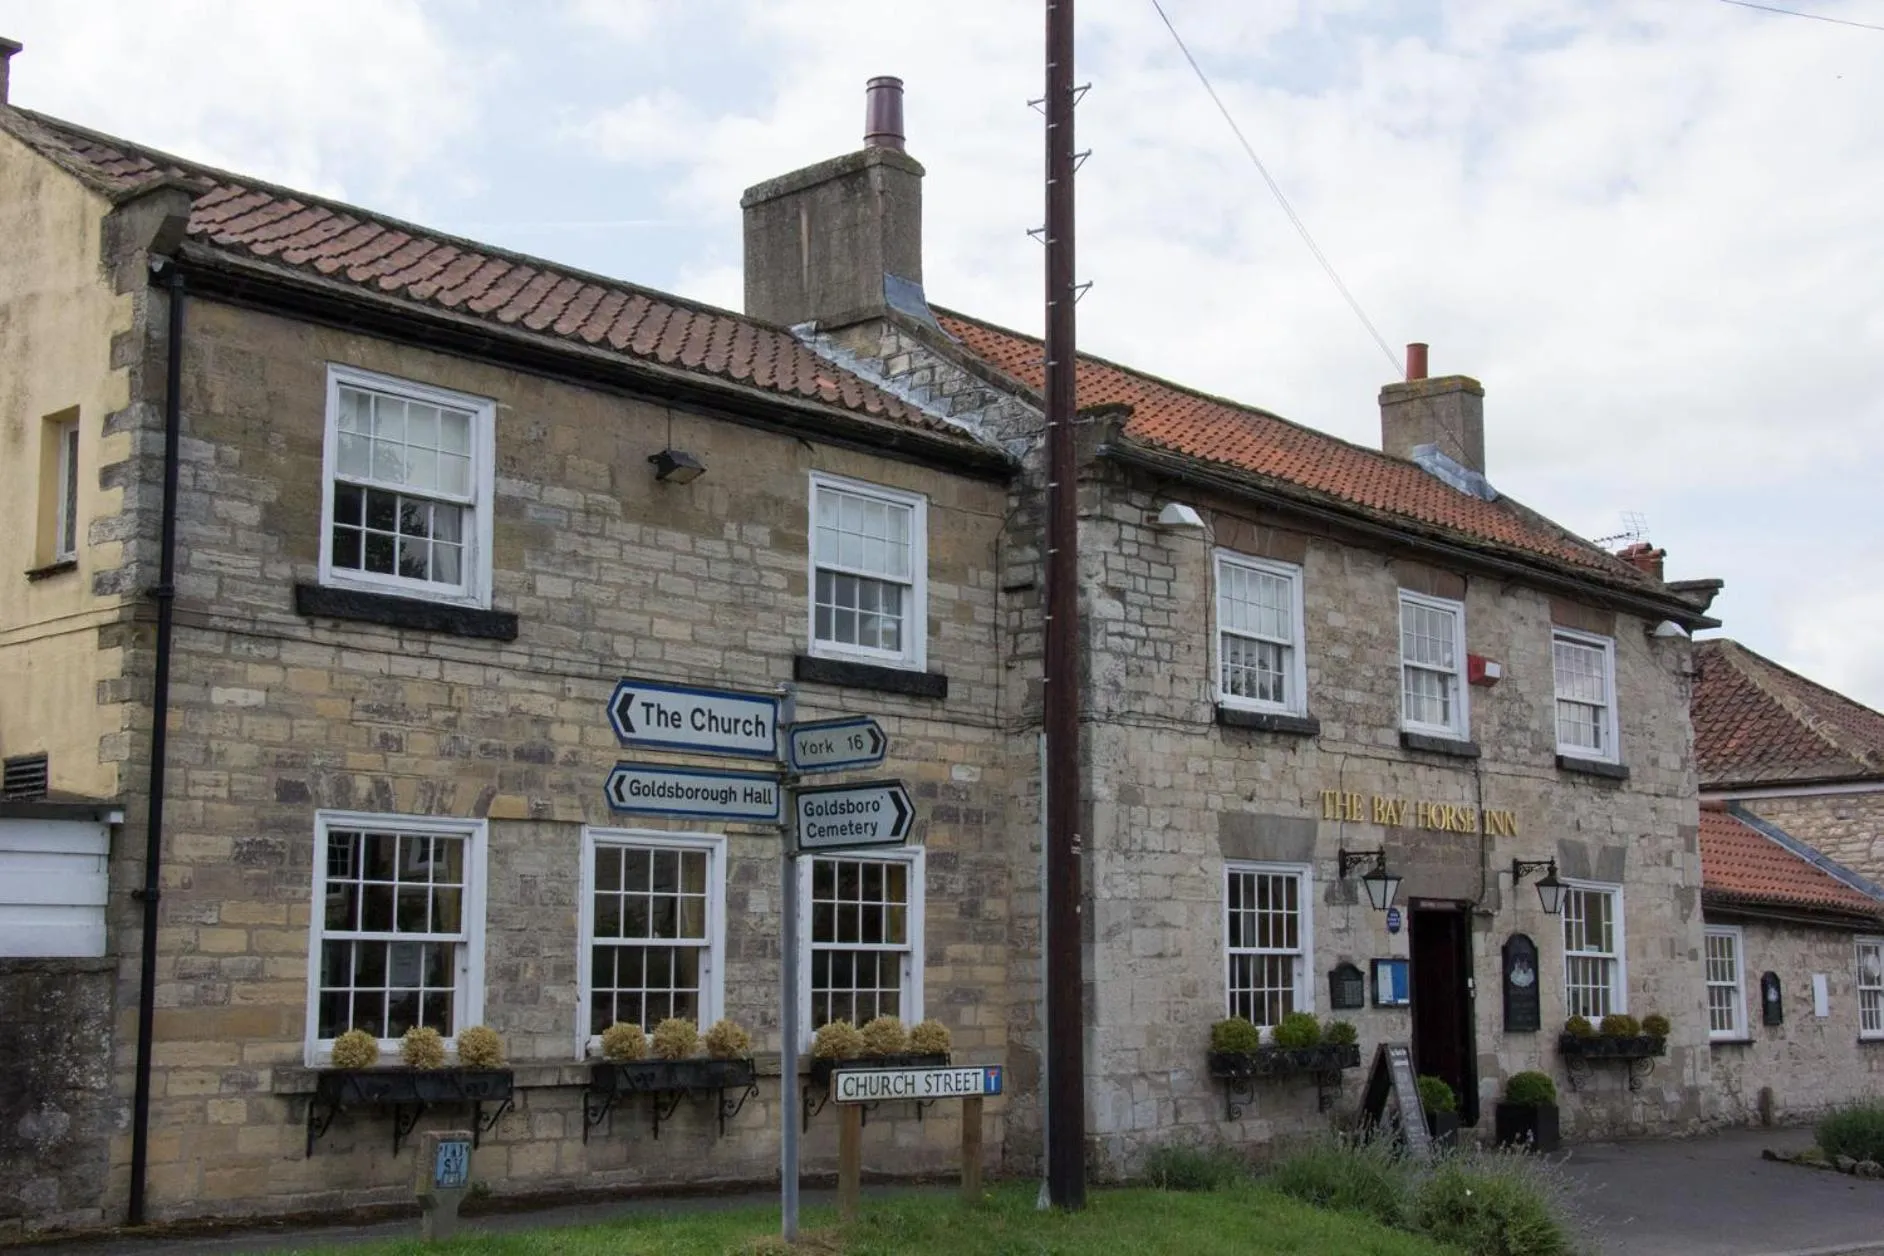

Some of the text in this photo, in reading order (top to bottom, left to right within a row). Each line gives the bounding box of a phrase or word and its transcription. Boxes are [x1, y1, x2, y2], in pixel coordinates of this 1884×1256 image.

[641, 702, 766, 738] The Church
[799, 734, 864, 756] York 16
[629, 779, 773, 804] Goldsborough Hall
[1319, 789, 1518, 836] THE BAY HORSE INN
[806, 820, 878, 838] Cemetery
[843, 1072, 980, 1096] CHURCH STREET
